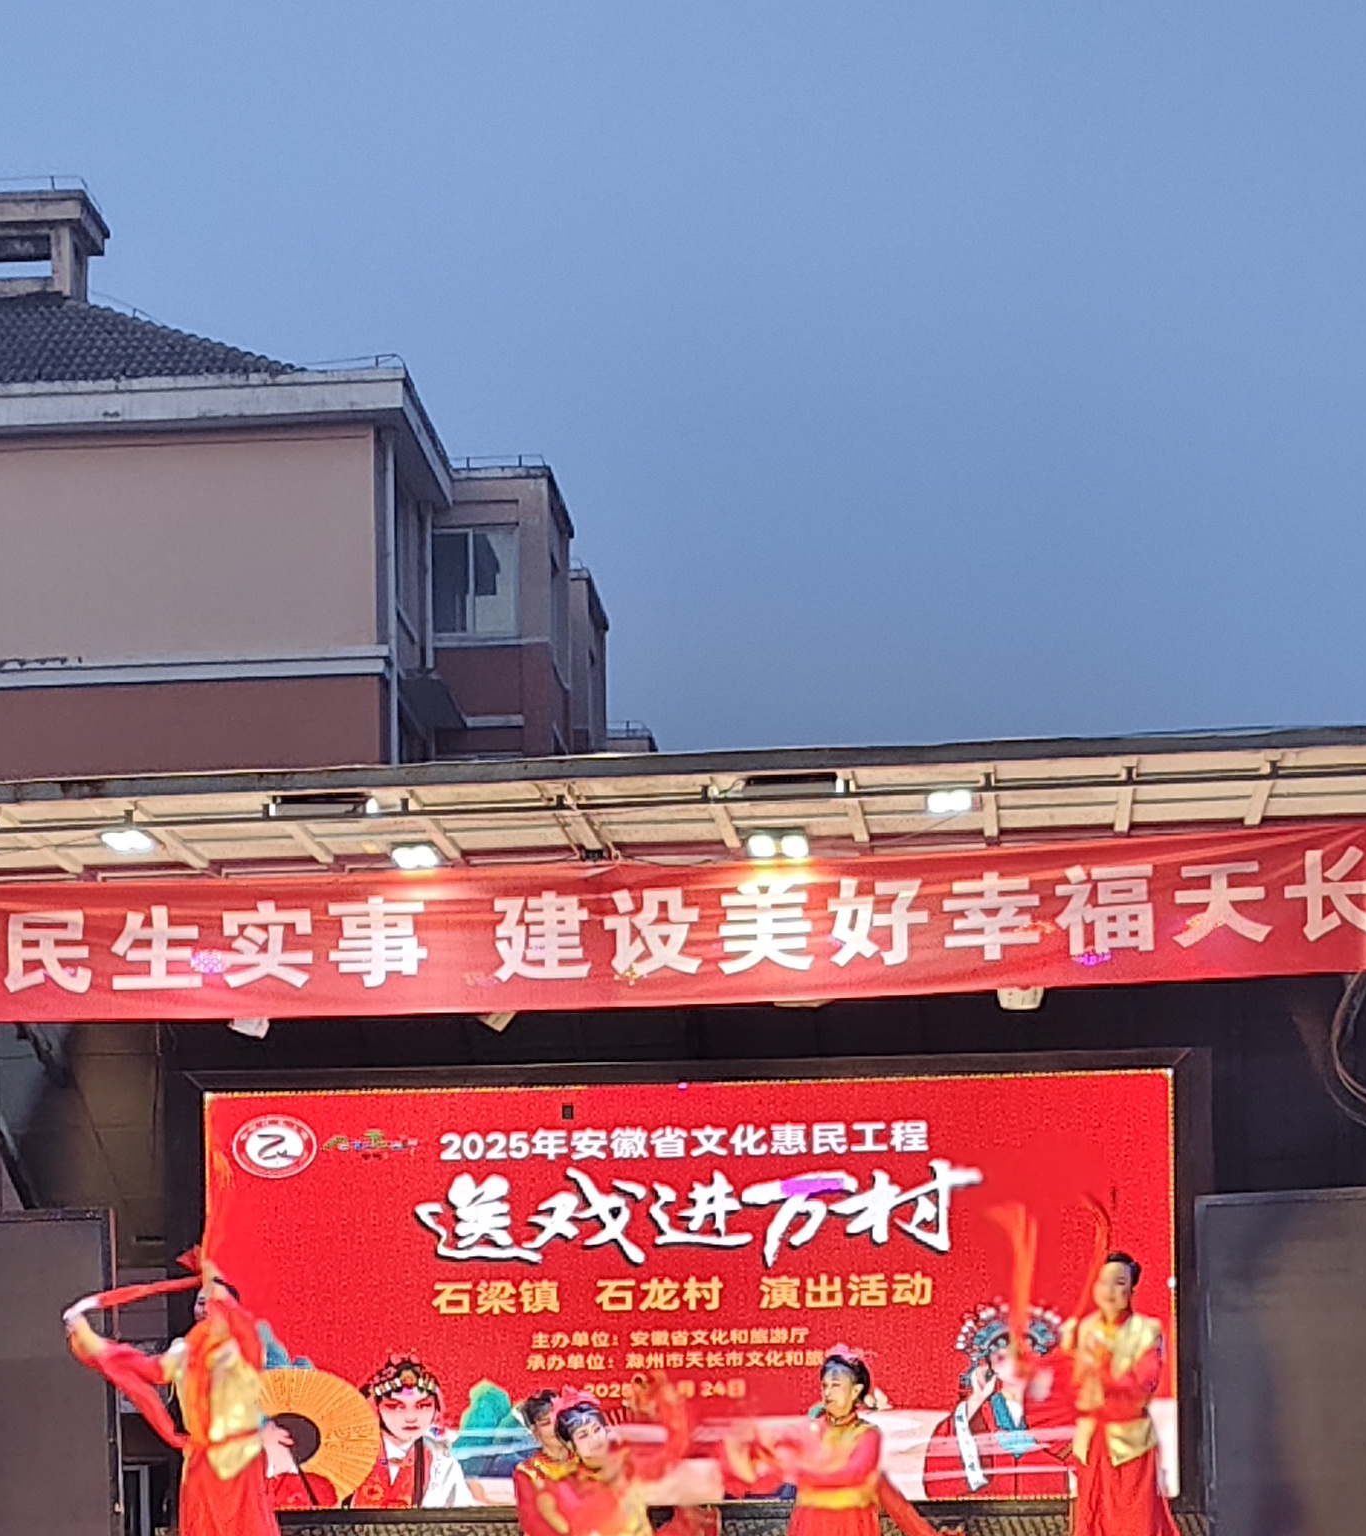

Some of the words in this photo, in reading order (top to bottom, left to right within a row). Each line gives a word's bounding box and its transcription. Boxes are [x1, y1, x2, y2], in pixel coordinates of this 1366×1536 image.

[439, 1120, 930, 1161] 2025年安徽省文化惠民工程
[414, 1158, 982, 1268] 送戏进万村
[431, 1279, 561, 1315] 石梁镇
[595, 1276, 724, 1312] 石龙村
[759, 1272, 933, 1309] 演出活动
[630, 1327, 809, 1347] 安徽省文化和旅游厅
